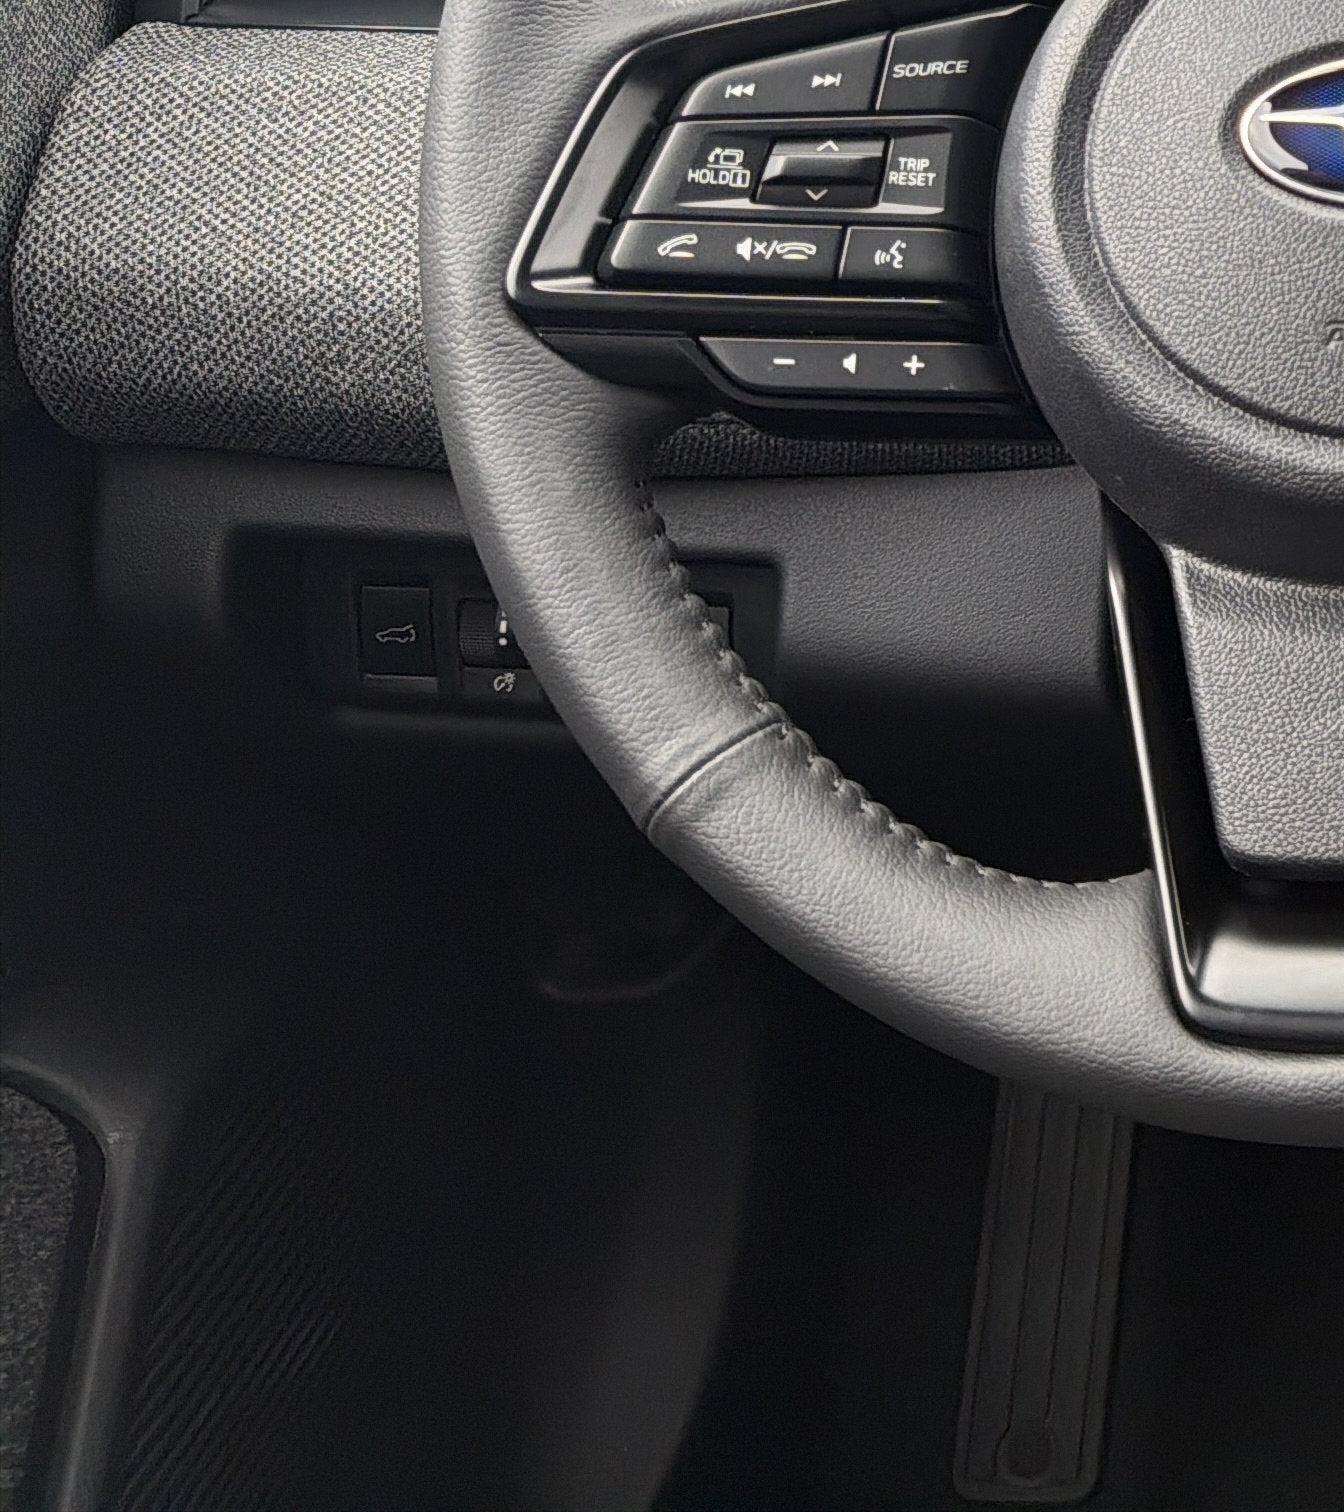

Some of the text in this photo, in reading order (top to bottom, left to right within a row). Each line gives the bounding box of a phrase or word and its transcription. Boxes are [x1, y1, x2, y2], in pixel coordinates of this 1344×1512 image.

[892, 59, 970, 78] SOURCE
[898, 157, 930, 172] TRIP
[687, 168, 730, 185] HOLD
[888, 171, 936, 187] RESET
